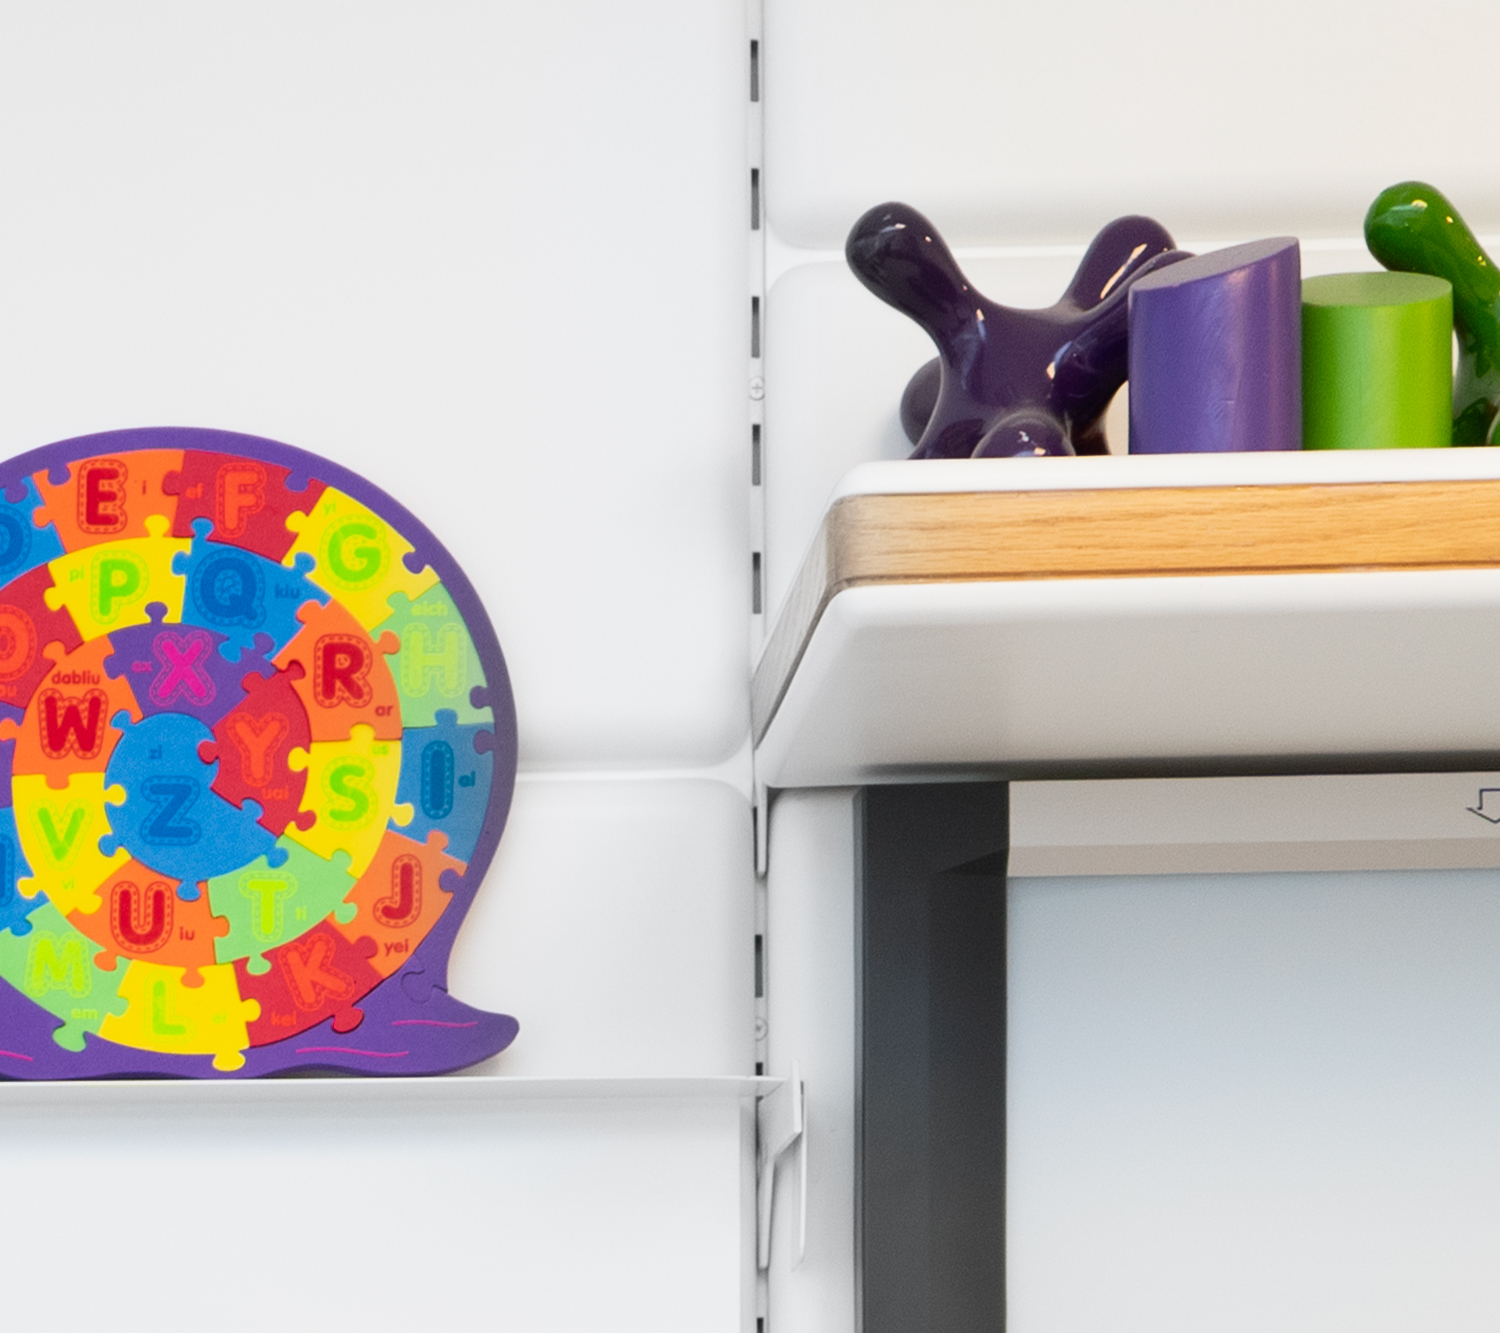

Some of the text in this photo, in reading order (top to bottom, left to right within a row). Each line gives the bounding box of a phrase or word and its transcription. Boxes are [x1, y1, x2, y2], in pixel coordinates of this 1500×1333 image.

[82, 464, 124, 530] E
[220, 467, 264, 533] F
[324, 519, 385, 587] G
[95, 555, 144, 620] P
[196, 553, 262, 624] Q
[51, 670, 101, 687] dabliu
[155, 635, 210, 702] X
[319, 638, 368, 704] R
[405, 628, 463, 692] H
[41, 691, 105, 756] W
[374, 703, 393, 718] ar
[231, 717, 285, 783] Y
[425, 743, 450, 817] I
[145, 779, 197, 842] Z
[325, 760, 373, 825] S
[33, 804, 89, 865] V
[115, 885, 169, 949] U
[243, 877, 291, 938] T
[378, 859, 417, 924] J
[26, 934, 88, 995] M
[178, 925, 195, 942] iu
[383, 938, 409, 957] yei
[282, 935, 348, 1008] K
[148, 976, 190, 1039] L
